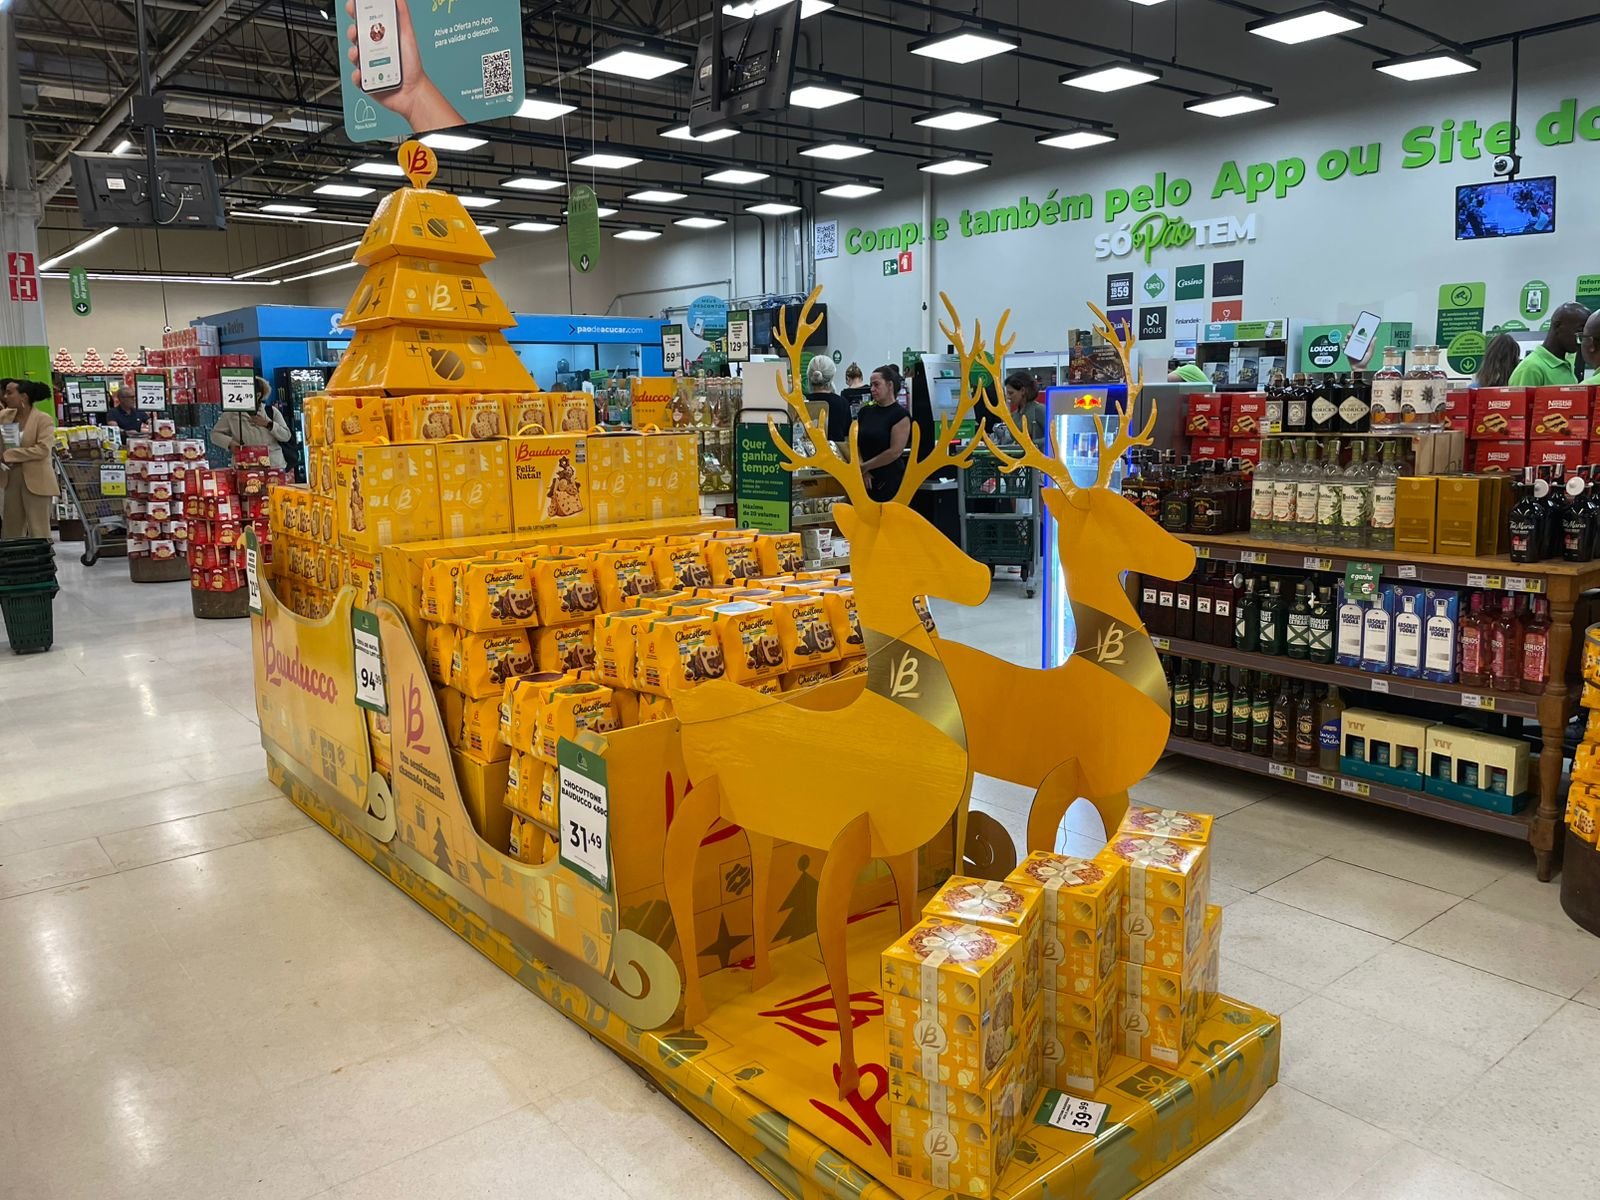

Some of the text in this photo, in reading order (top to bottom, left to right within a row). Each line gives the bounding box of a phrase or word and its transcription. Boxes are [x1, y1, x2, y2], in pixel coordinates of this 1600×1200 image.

[434, 27, 449, 37] Ative
[453, 22, 471, 32] Oferta
[472, 19, 480, 27] no
[480, 16, 493, 26] App
[434, 38, 448, 48] para
[448, 33, 466, 44] validar
[959, 188, 1093, 238] também
[1104, 171, 1192, 222] pelo
[1211, 159, 1305, 202] App
[1317, 142, 1381, 182] ou
[1401, 119, 1520, 169] Site
[1094, 223, 1132, 259] SÓ
[1133, 212, 1195, 264] Pão
[1191, 213, 1257, 246] TEM
[1177, 278, 1203, 288] Casino
[577, 324, 644, 335] paodeacucar.com
[1143, 325, 1163, 334] nous
[1310, 345, 1339, 353] LOUCOS
[1488, 400, 1511, 409] Nestlé
[1548, 399, 1573, 409] Nestlé
[742, 439, 767, 450] Quer
[514, 441, 571, 463] Bauducco
[742, 451, 778, 463] ganhar
[516, 465, 537, 474] Feliz
[742, 463, 780, 476] tempo?
[516, 471, 542, 481] Natal!
[757, 511, 780, 519] volumes
[485, 572, 524, 584] Chocottone
[553, 567, 588, 579] Chocottone
[1355, 573, 1374, 582] ganhe
[1146, 593, 1154, 601] 24
[1162, 596, 1170, 604] 24
[1200, 602, 1209, 610] 24
[1218, 605, 1227, 613] 24
[792, 606, 824, 620] Chocottone
[1341, 613, 1361, 621] ABSOLUT
[738, 618, 774, 632] Chocottone
[1342, 618, 1359, 626] VODKA
[1367, 618, 1387, 627] ABSOLUT
[1368, 623, 1385, 631] VODKA
[1398, 622, 1419, 631] ABSOLUT
[555, 629, 590, 641] Chocottone
[1428, 626, 1451, 634] ABSOLUT
[1430, 631, 1449, 639] VODKA
[675, 628, 712, 643] Chocottone
[483, 637, 522, 650] Chocottone
[261, 606, 338, 705] Bauducco
[572, 700, 612, 716] Chocottone
[563, 779, 602, 804] CHOCOTTONE
[561, 787, 592, 809] BAUDUCCO
